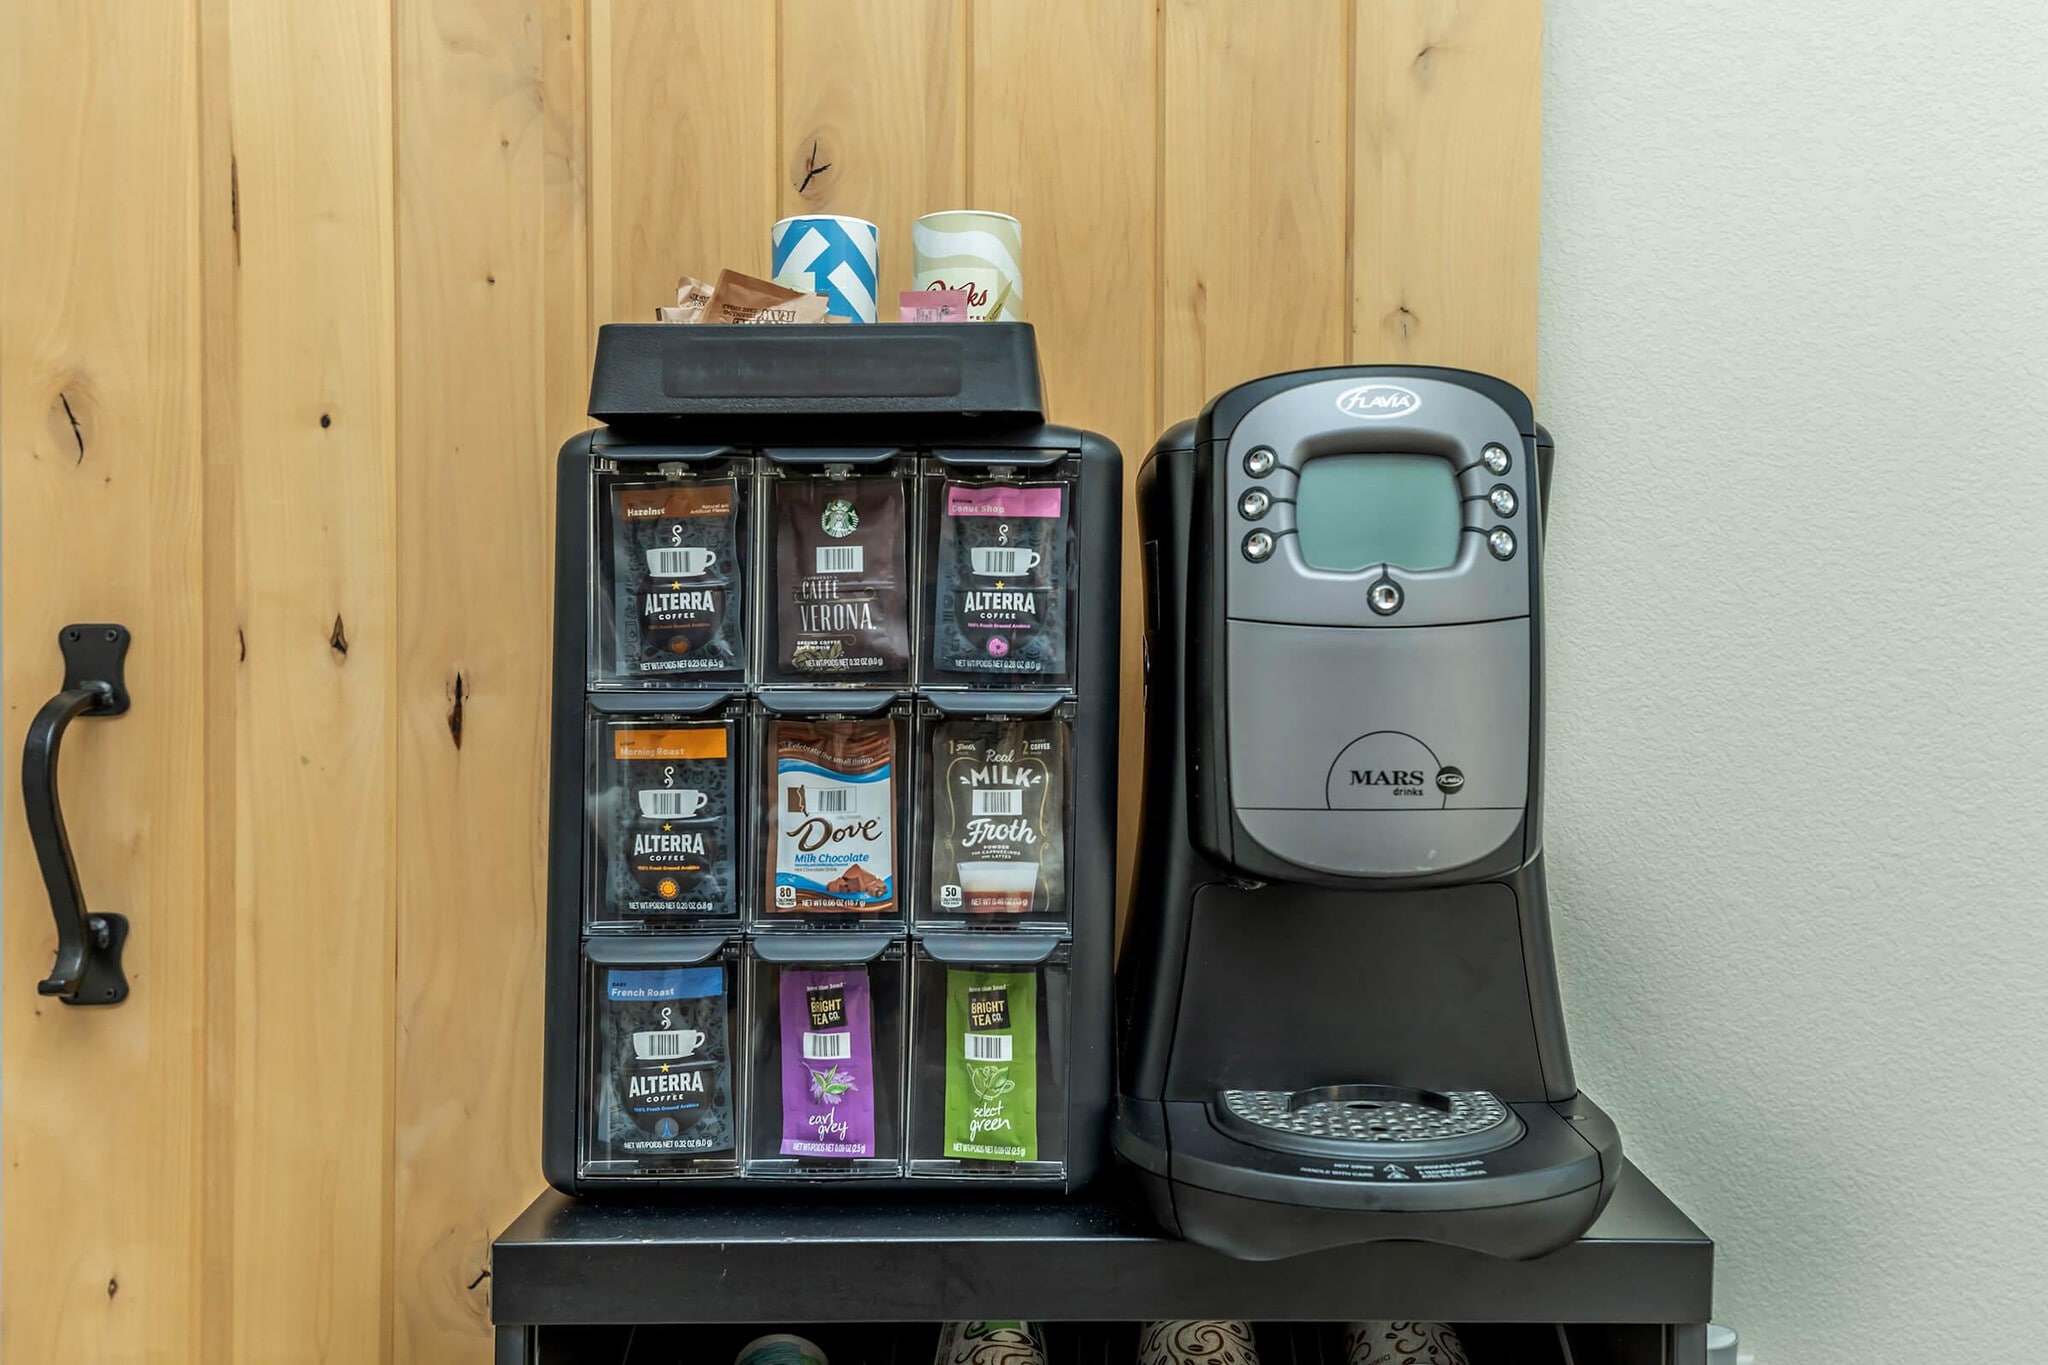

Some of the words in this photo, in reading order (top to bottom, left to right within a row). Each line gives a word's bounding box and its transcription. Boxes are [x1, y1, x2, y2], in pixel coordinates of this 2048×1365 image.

[1345, 389, 1411, 411] FLAVIA
[627, 507, 665, 517] Hazelnut
[981, 505, 1005, 513] Shop
[645, 590, 715, 616] ALTERRA
[964, 592, 1036, 614] ALTERRA
[659, 612, 695, 620] COFFEE
[620, 748, 655, 757] Morning
[656, 747, 684, 755] Roast
[1022, 741, 1029, 755] 2
[833, 757, 851, 765] small
[986, 748, 1015, 763] Real
[970, 765, 1033, 788] MILK
[1350, 770, 1424, 786] MARS
[1393, 788, 1423, 796] drinks
[787, 817, 882, 852] Dove
[962, 818, 1036, 847] Froth
[634, 833, 705, 856] ALTERRA
[794, 854, 816, 863] Milk
[818, 853, 870, 863] Chocolate
[780, 888, 791, 898] 80
[945, 887, 957, 897] 50
[612, 988, 645, 997] French
[648, 988, 675, 997] Roast
[810, 998, 842, 1013] BRIGHT
[971, 1000, 1005, 1014] BRIGHT
[812, 1013, 829, 1025] TEA
[972, 1014, 992, 1026] TEA
[629, 1071, 704, 1098] ALTERRA
[646, 1094, 684, 1103] COFFEE
[809, 1107, 835, 1125] earl
[974, 1100, 1004, 1118] select
[818, 1120, 848, 1141] grey
[970, 1118, 1011, 1142] green
